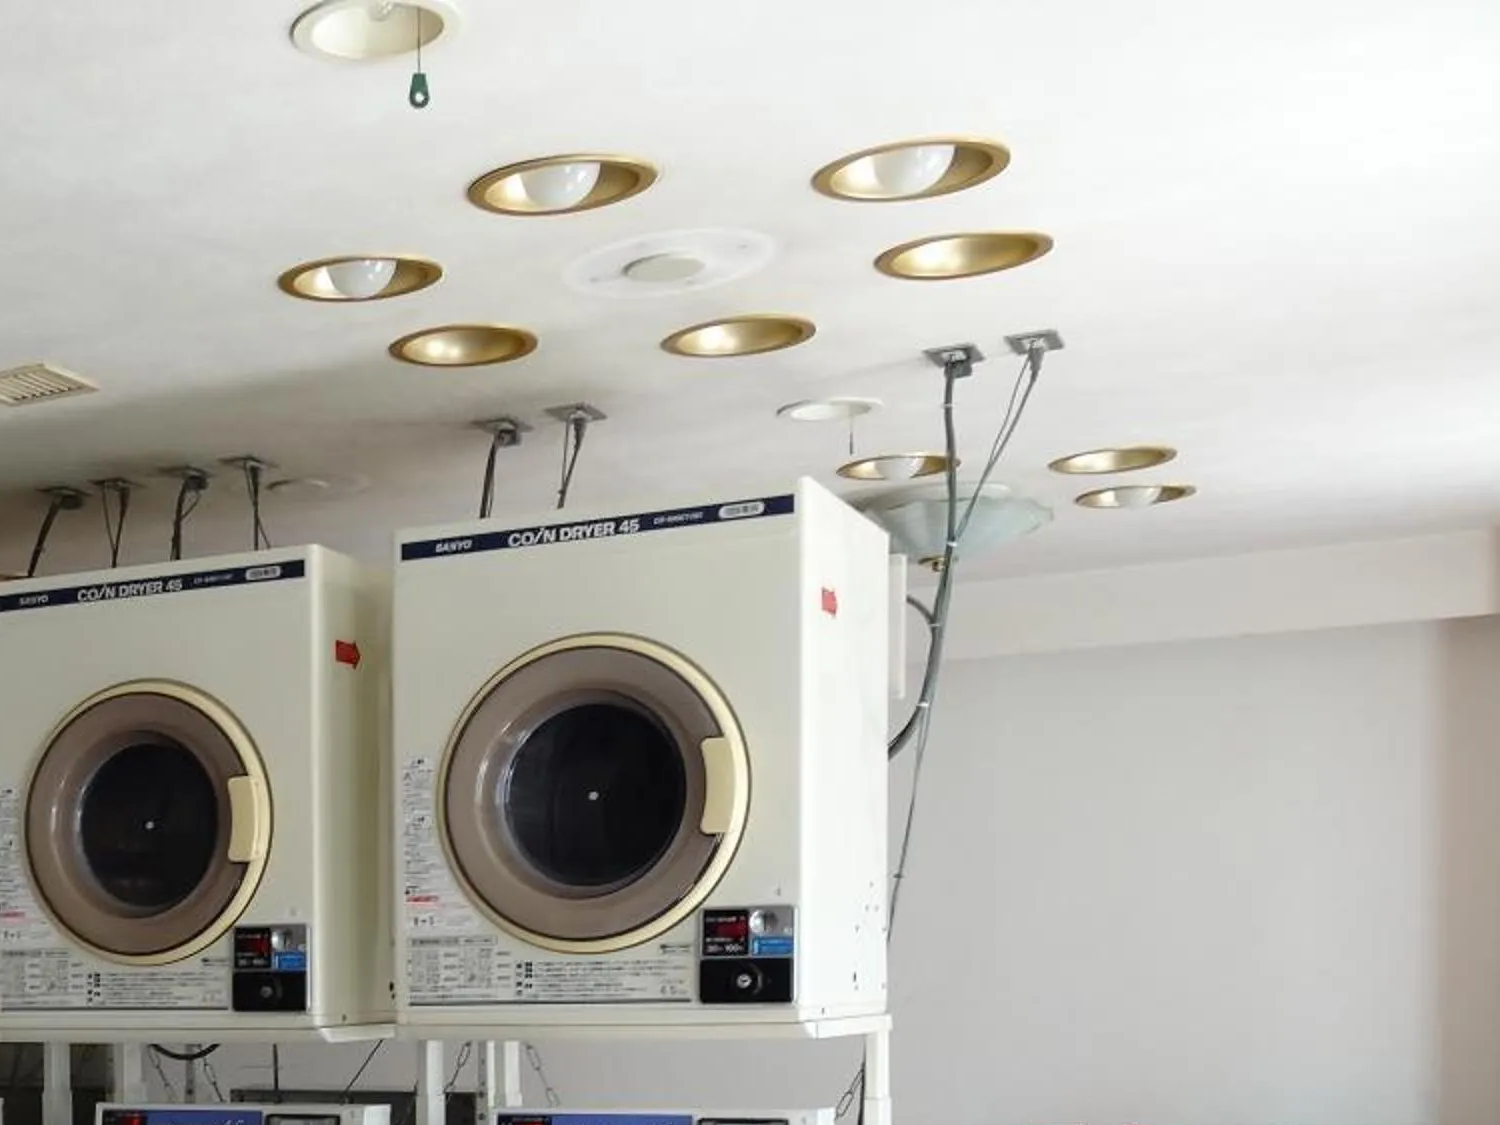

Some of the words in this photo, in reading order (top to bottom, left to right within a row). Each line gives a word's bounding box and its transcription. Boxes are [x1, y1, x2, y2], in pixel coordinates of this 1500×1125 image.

[435, 539, 472, 553] SANYO
[559, 522, 617, 543] DRYER
[618, 519, 641, 535] 45
[119, 581, 164, 598] DRYER
[165, 578, 184, 592] 45
